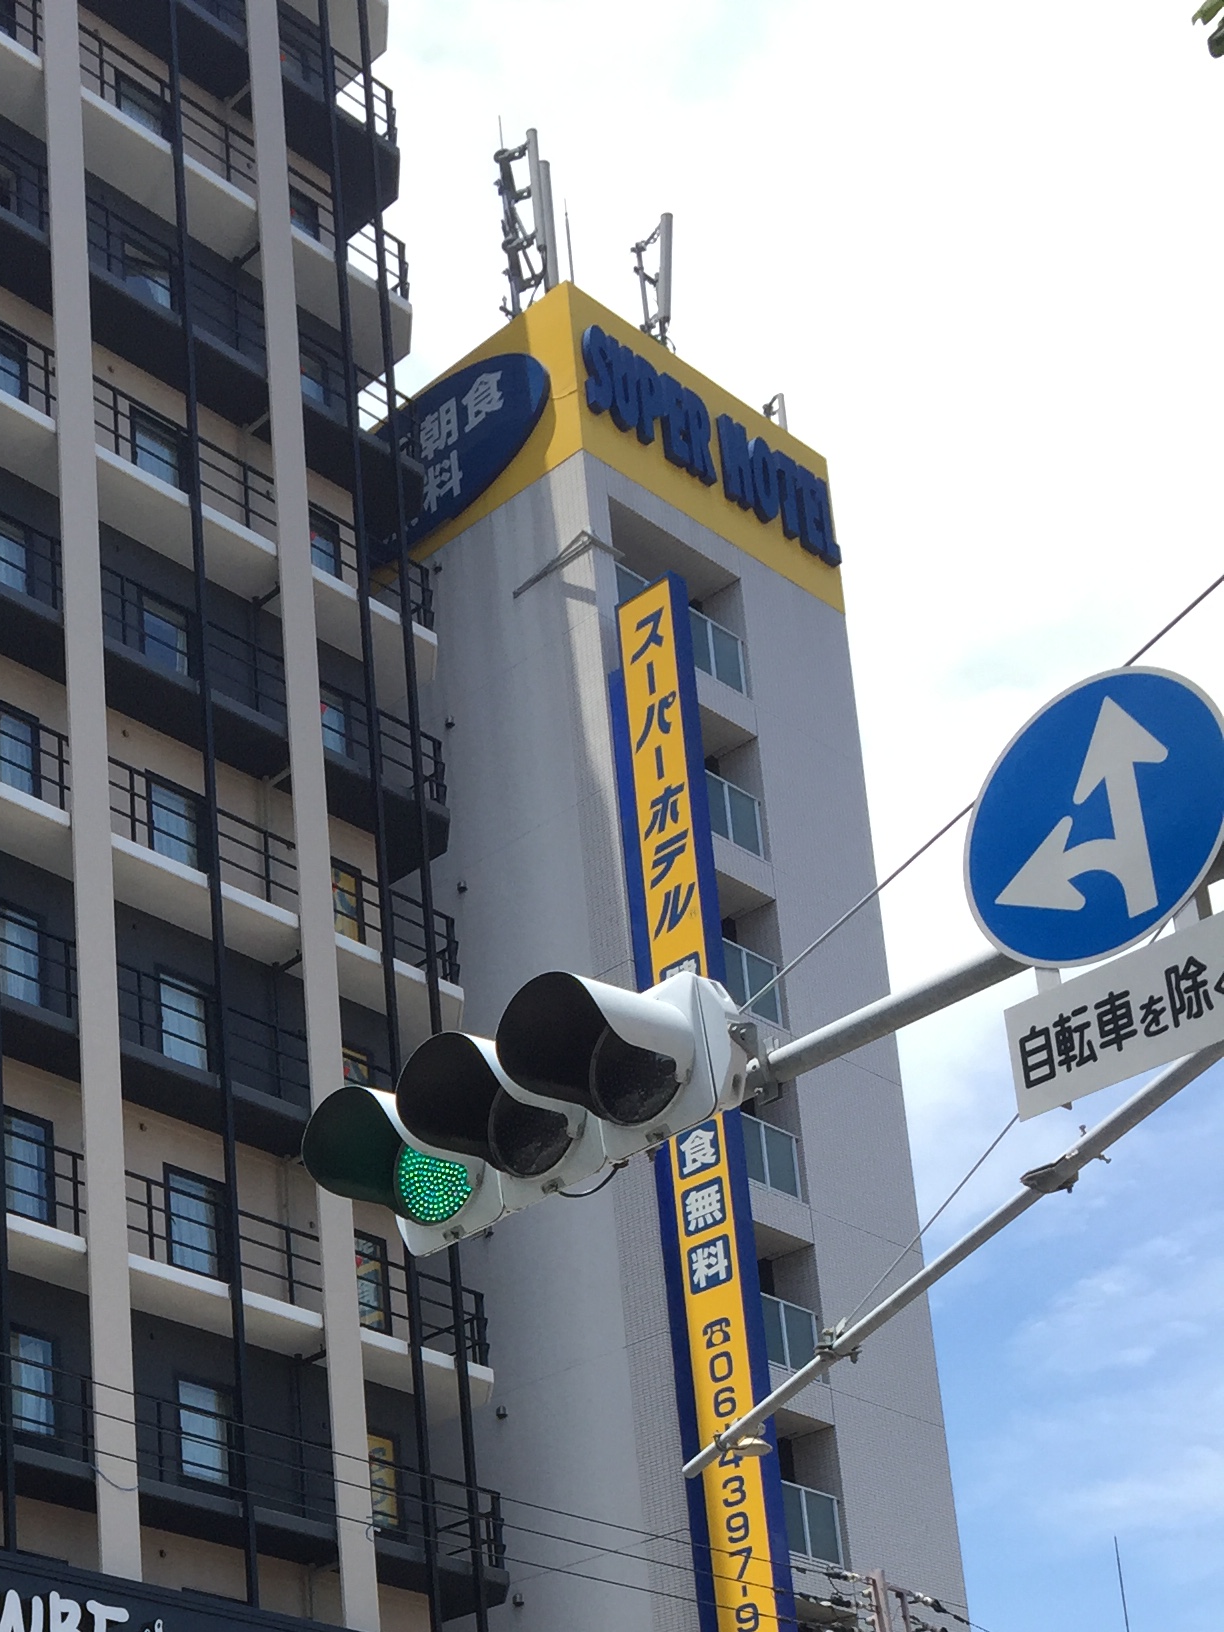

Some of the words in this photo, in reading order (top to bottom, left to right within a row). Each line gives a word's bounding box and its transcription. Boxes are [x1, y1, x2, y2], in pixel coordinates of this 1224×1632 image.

[398, 371, 505, 461] 朝食
[423, 450, 464, 514] 料
[581, 325, 718, 488] SUPER
[716, 413, 843, 568] HOTEL
[630, 606, 696, 941] スーパーホテル
